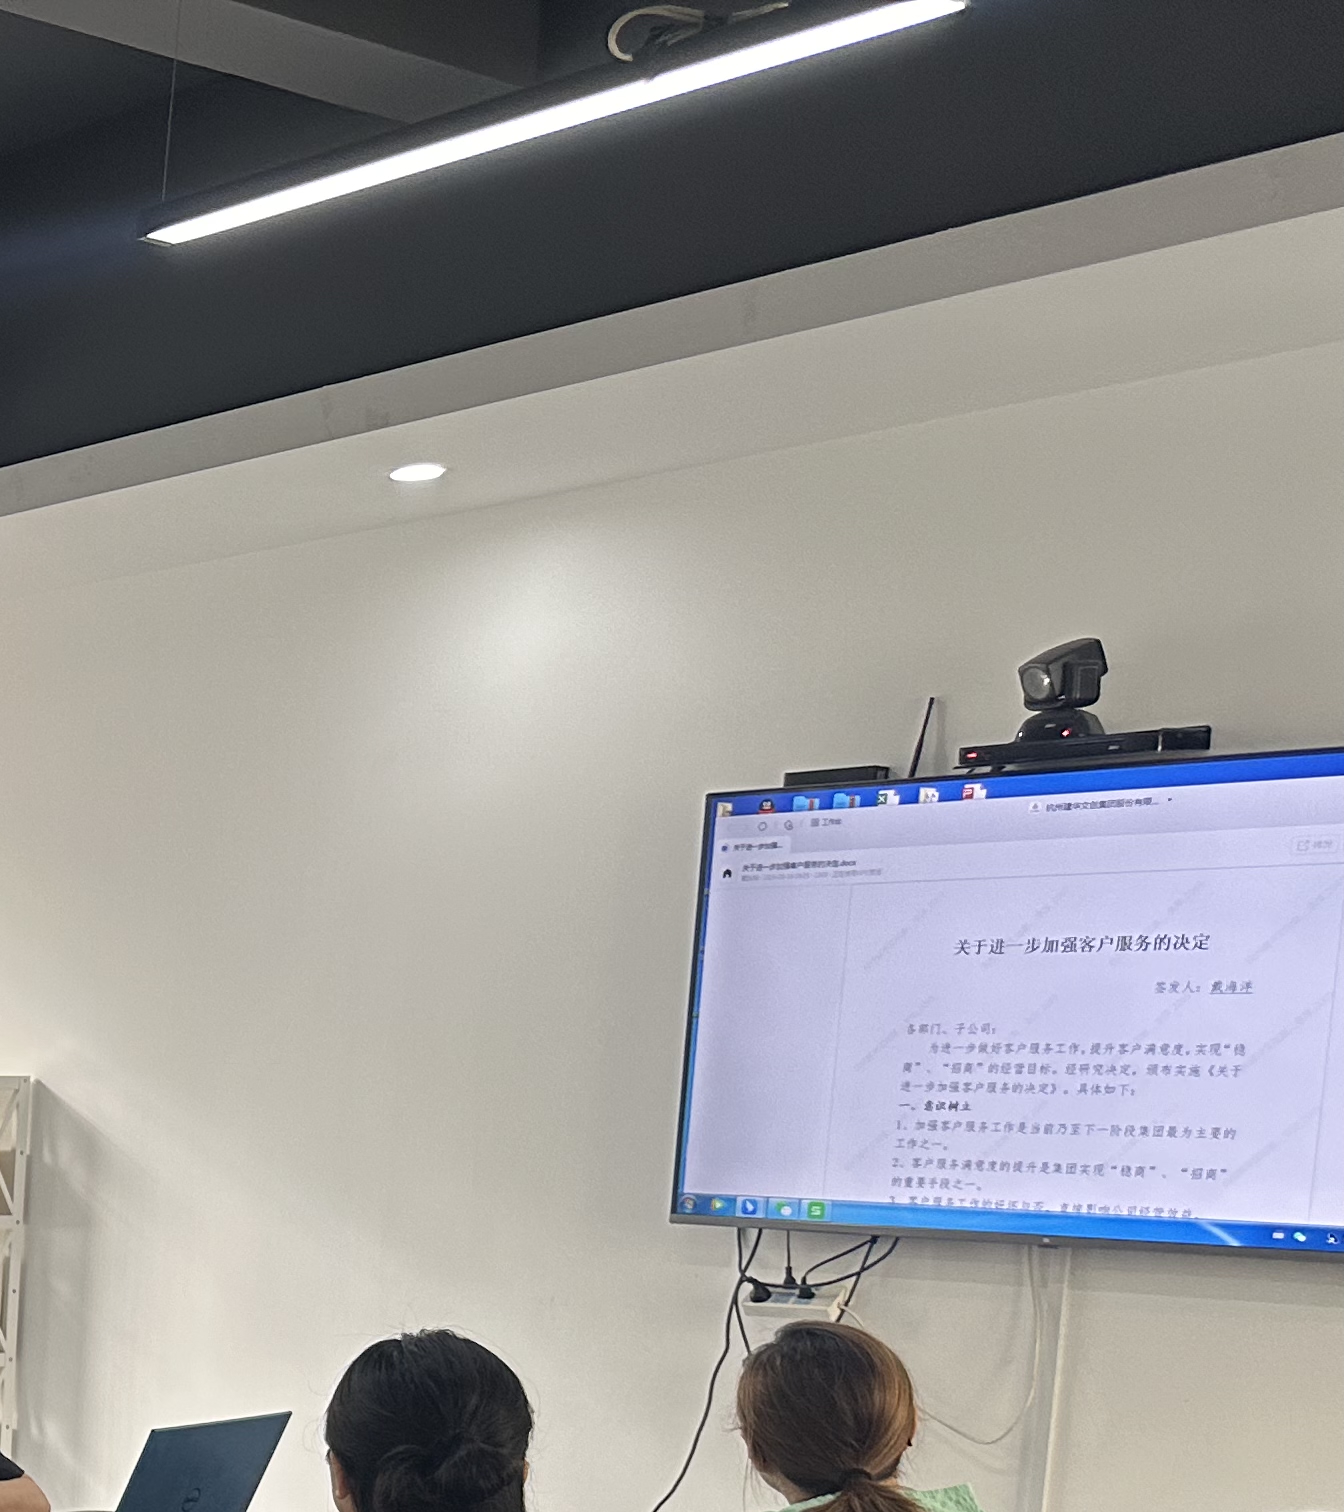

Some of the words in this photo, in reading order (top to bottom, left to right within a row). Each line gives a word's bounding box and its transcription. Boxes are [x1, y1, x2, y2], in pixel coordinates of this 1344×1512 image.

[953, 933, 1210, 956] 关于进一步加强客户服务的决定
